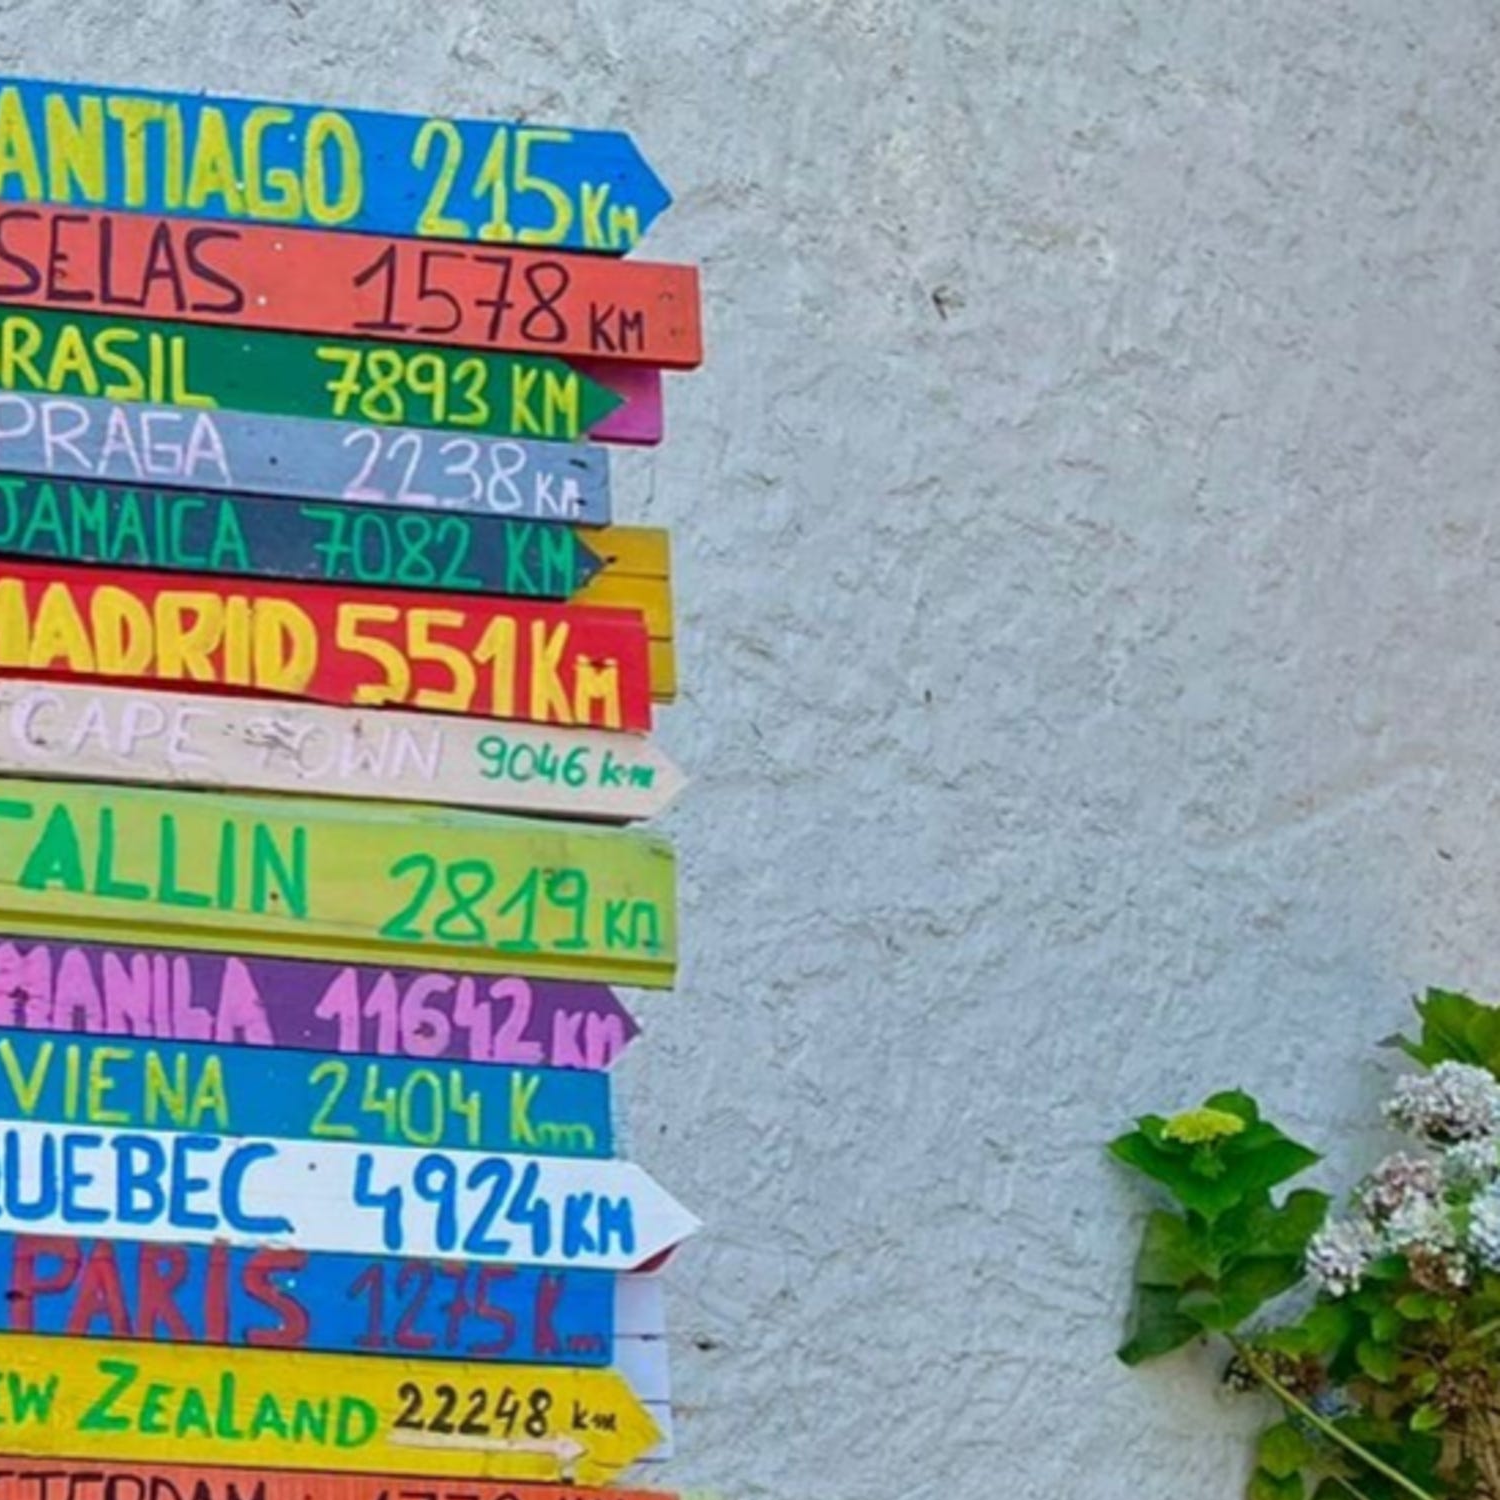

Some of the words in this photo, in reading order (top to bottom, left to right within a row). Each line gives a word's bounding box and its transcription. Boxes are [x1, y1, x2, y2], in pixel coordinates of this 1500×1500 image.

[411, 120, 573, 244] 215
[352, 243, 570, 343] 1578
[589, 303, 645, 353] KM
[315, 345, 490, 427] 7893
[511, 364, 579, 438] KM
[342, 427, 527, 511] 2238
[303, 507, 483, 589] 7082
[504, 523, 576, 598] KM
[9, 692, 218, 764] CAPE
[477, 735, 590, 788] 9046
[379, 853, 589, 954] 2819
[314, 965, 544, 1065] 11642
[307, 1060, 481, 1145] 2404
[353, 1153, 553, 1257] 4924
[8, 1236, 311, 1350] PARIS
[351, 1262, 517, 1357] 1275
[394, 1383, 553, 1438] 22248
